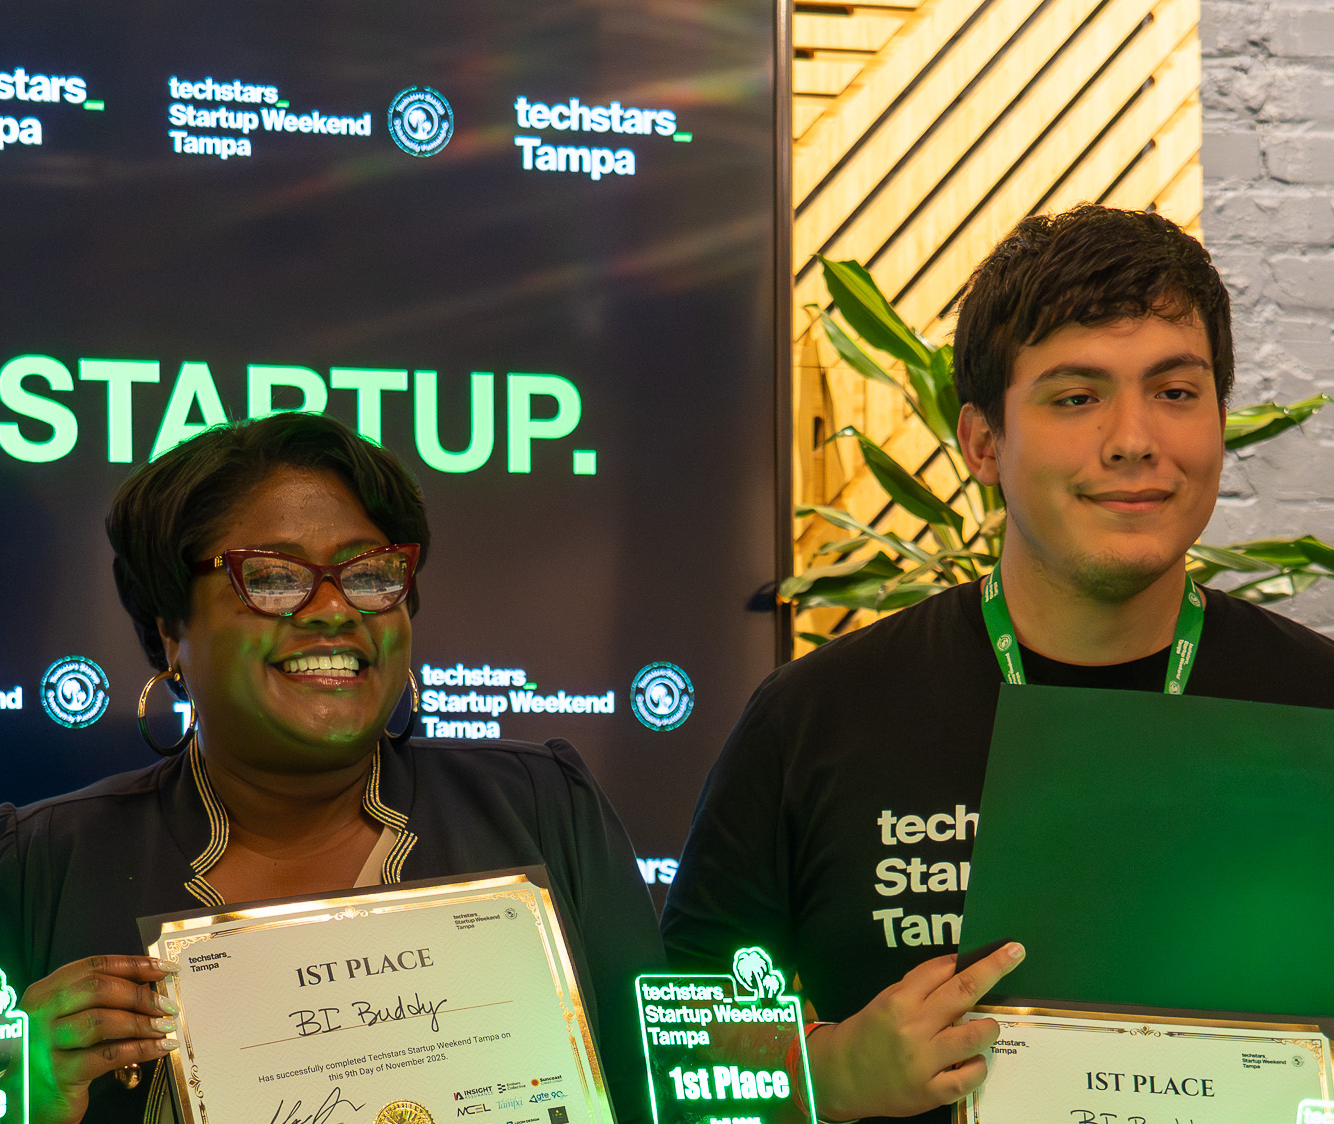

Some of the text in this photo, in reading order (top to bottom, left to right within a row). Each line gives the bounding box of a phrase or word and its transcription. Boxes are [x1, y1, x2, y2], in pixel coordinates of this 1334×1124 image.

[168, 101, 259, 134] Startup
[260, 107, 371, 137] Weekend
[168, 129, 251, 160] Tampa
[514, 135, 636, 181] Tampa
[421, 689, 615, 717] Startup Weekend
[421, 716, 501, 739] Tampa
[475, 914, 501, 923] Weekend
[190, 961, 220, 973] Tampa
[295, 947, 434, 987] 1ST PLACE
[288, 992, 447, 1037] BI Buddy
[645, 1004, 796, 1026] Startup Weekend
[647, 1027, 710, 1048] Tampa
[990, 1046, 1017, 1055] Tampa
[258, 1074, 275, 1083] Has
[275, 1064, 324, 1080] successfully
[325, 1055, 367, 1070] completed
[367, 1049, 407, 1062] Techstars
[407, 1044, 436, 1055] Startup
[436, 1036, 472, 1050] Weekend
[472, 1033, 500, 1043] Tampa
[328, 1052, 448, 1082] this 9th Day of November 2025.
[464, 1086, 493, 1096] INSIGHT
[669, 1065, 790, 1100] 1st Place
[1085, 1071, 1215, 1098] 1ST PLACE
